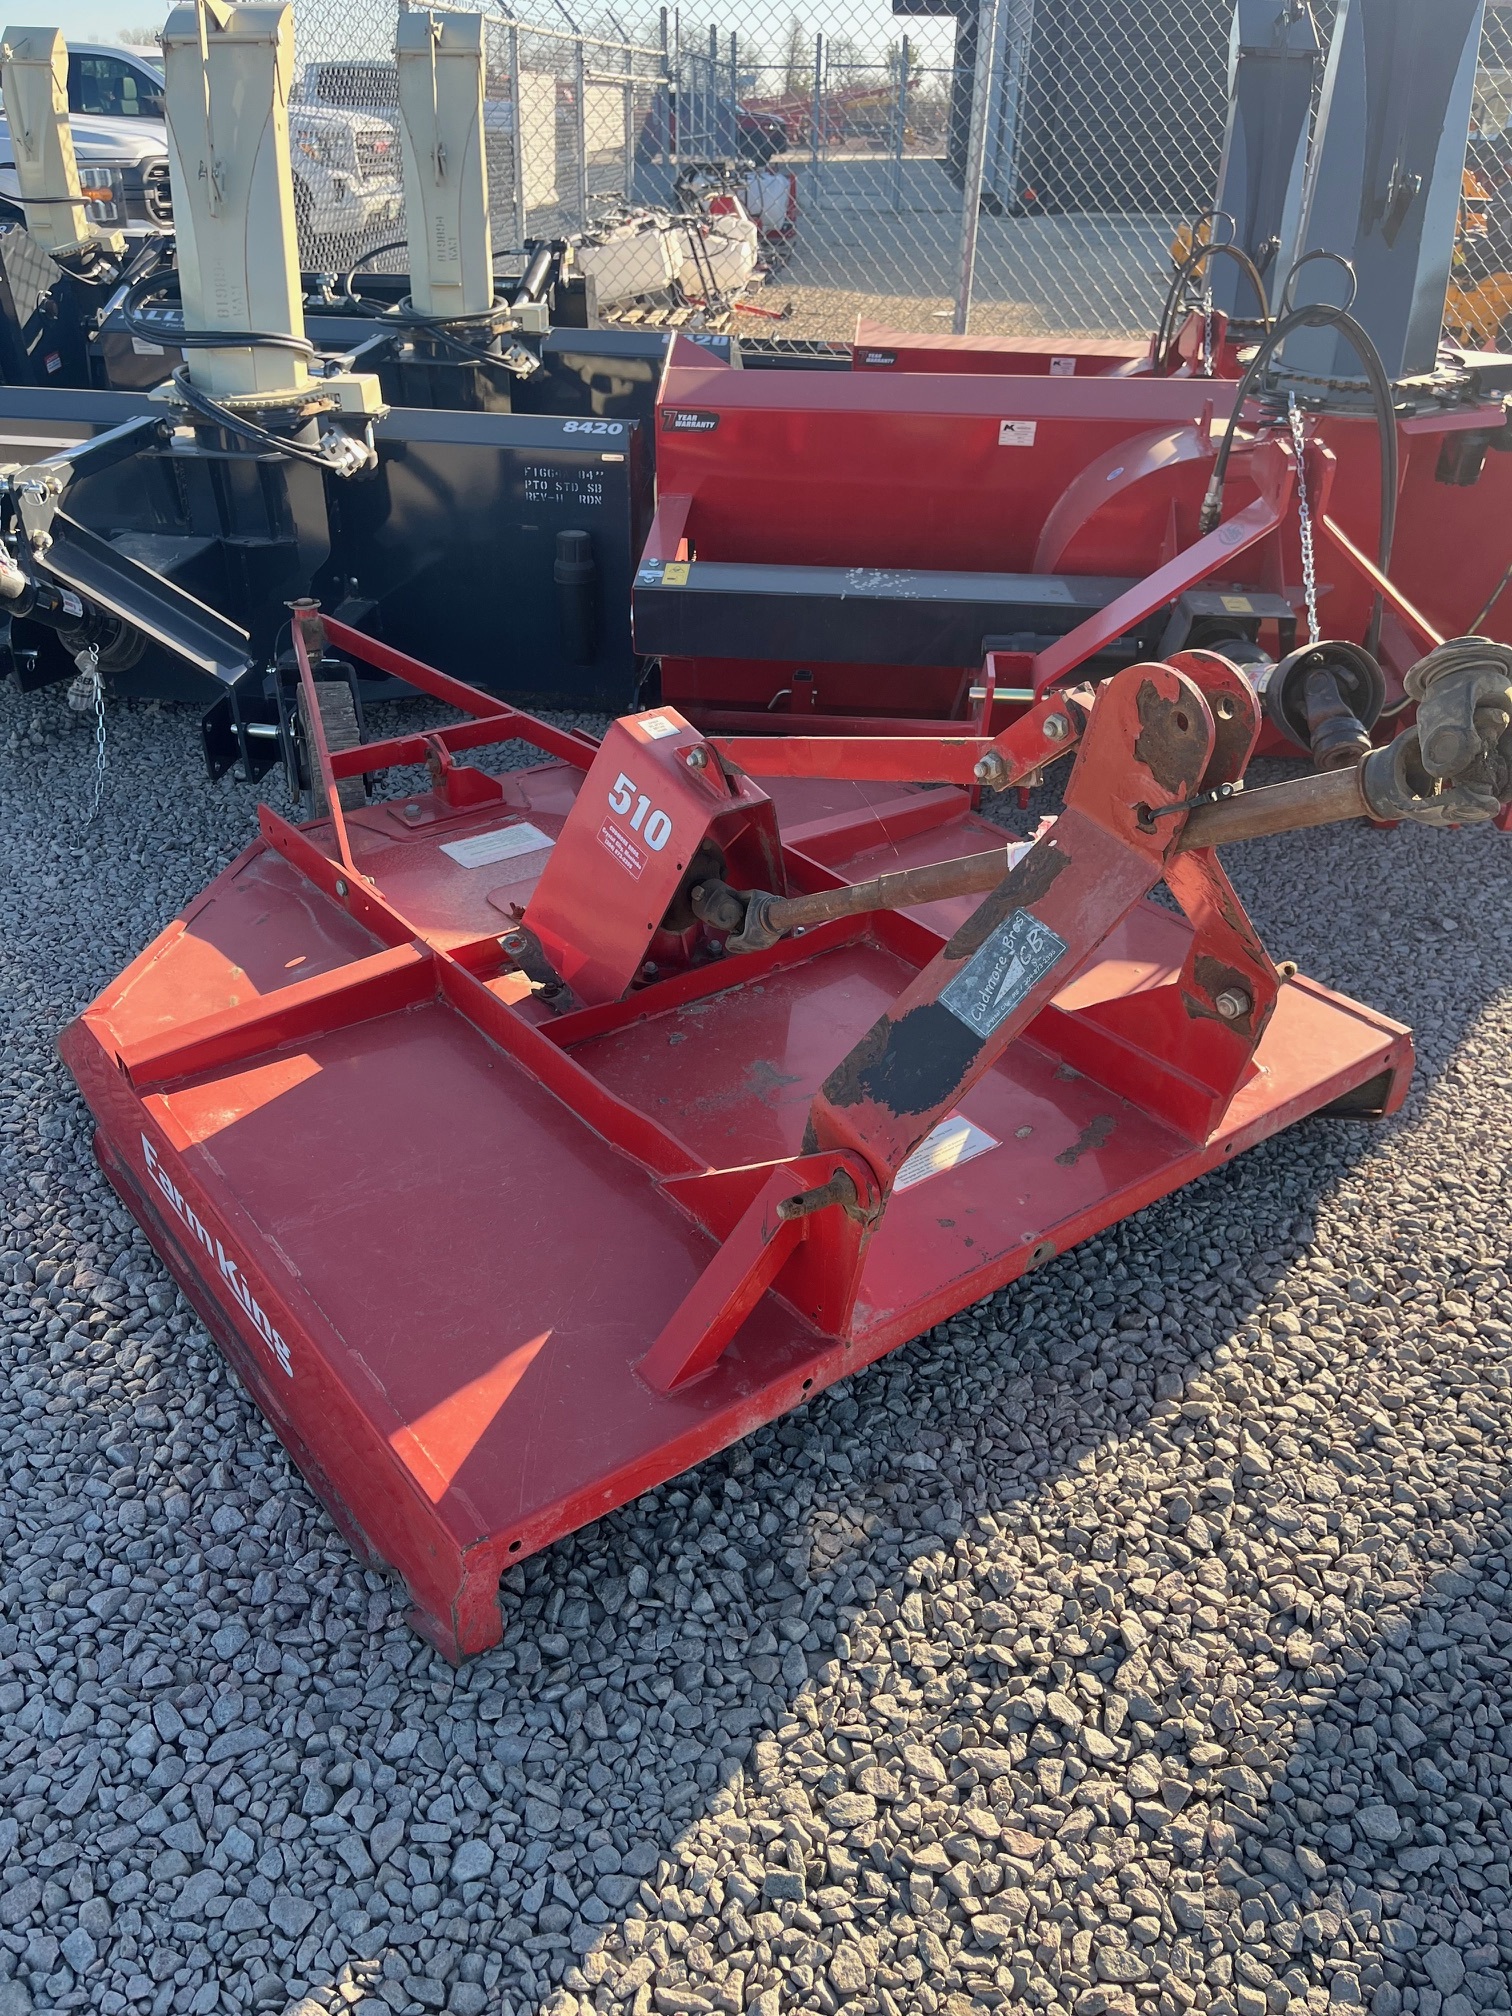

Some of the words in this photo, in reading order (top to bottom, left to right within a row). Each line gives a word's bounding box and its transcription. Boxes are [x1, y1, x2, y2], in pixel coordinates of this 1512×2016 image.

[675, 420, 716, 429] WARRANTY
[677, 414, 698, 422] YEAR
[562, 421, 623, 435] 8420
[555, 481, 579, 492] STD
[587, 483, 602, 494] SB
[578, 494, 602, 505] RDN
[607, 771, 673, 852] 510
[971, 956, 1007, 1021] Cudmore
[1002, 916, 1024, 950] Bros
